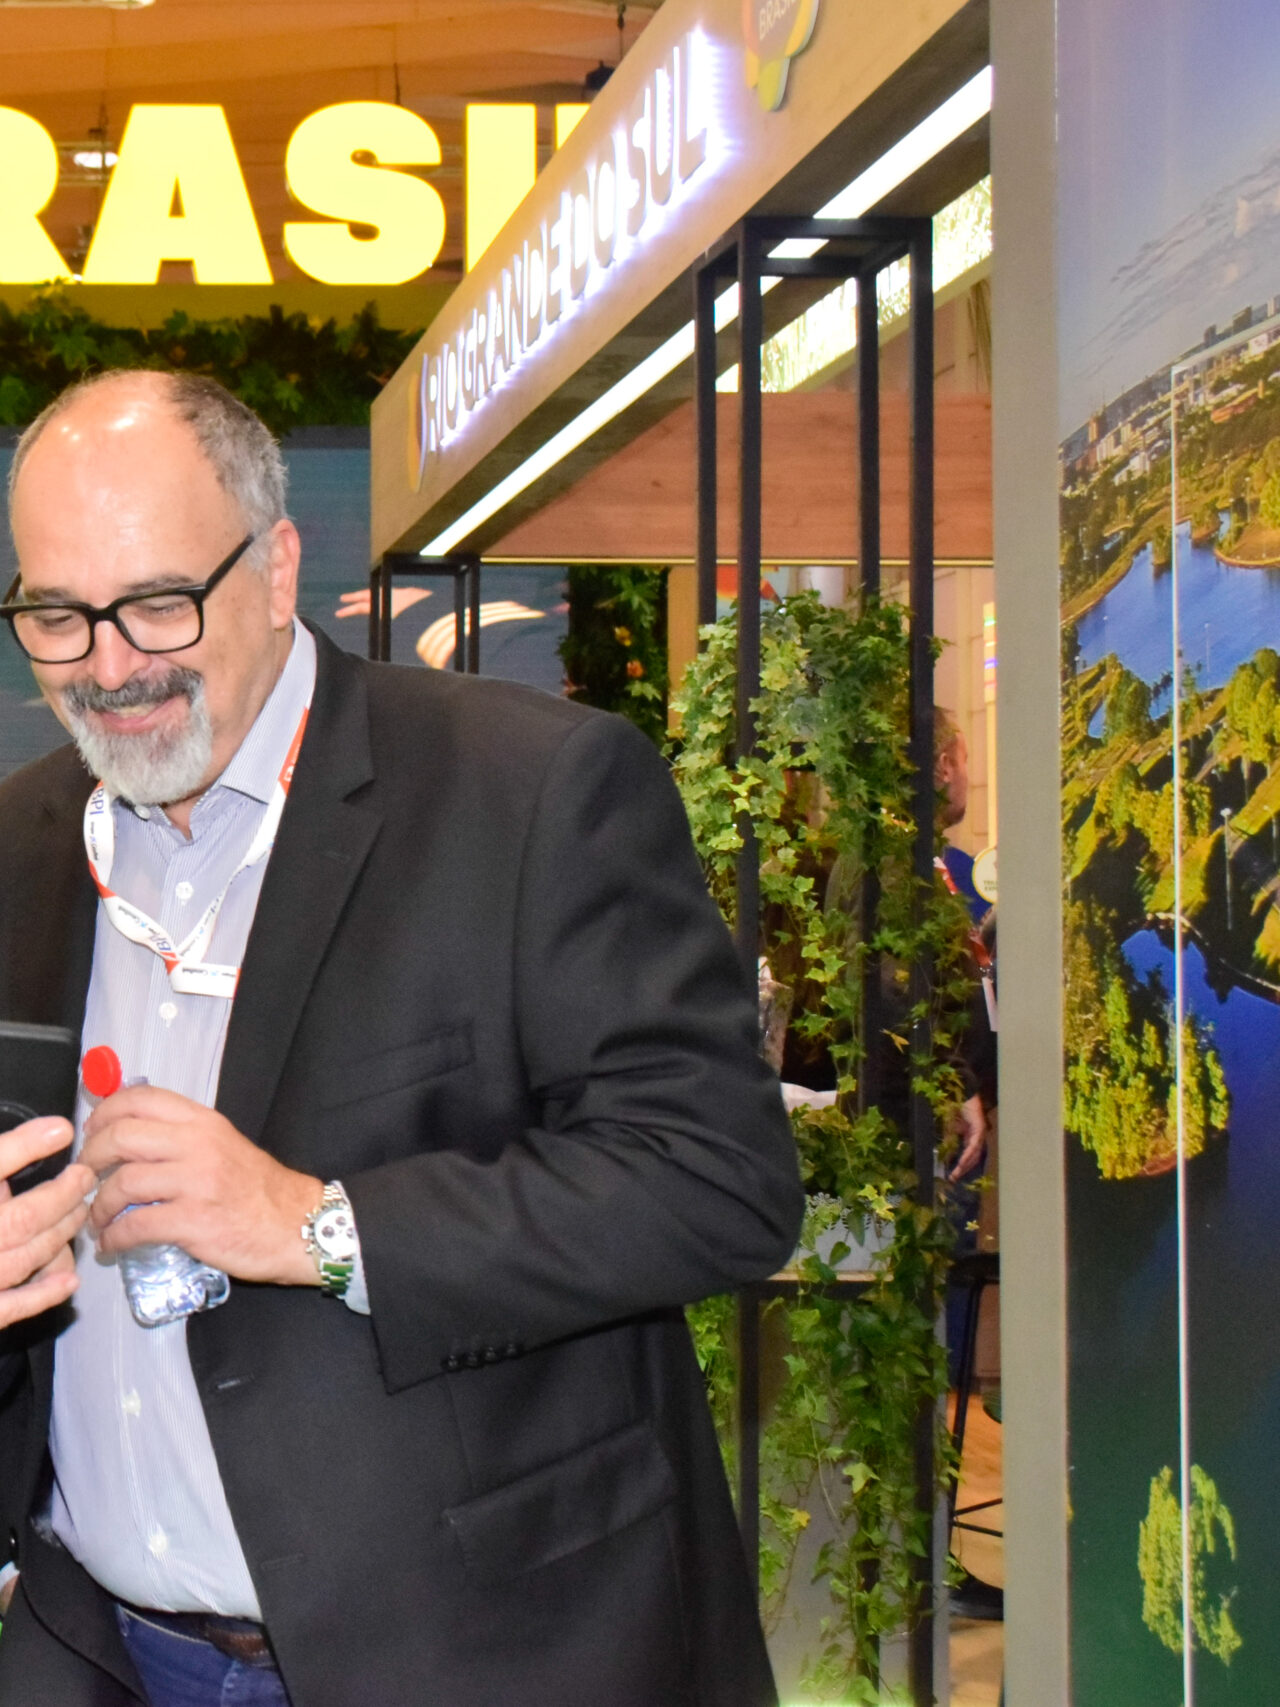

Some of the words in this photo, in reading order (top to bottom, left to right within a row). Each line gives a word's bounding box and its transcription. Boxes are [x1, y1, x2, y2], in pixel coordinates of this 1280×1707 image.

[426, 343, 459, 461] RIO
[461, 195, 565, 414] GRANDE
[567, 140, 618, 303] DO
[620, 30, 708, 238] SUL
[88, 787, 105, 815] BPI
